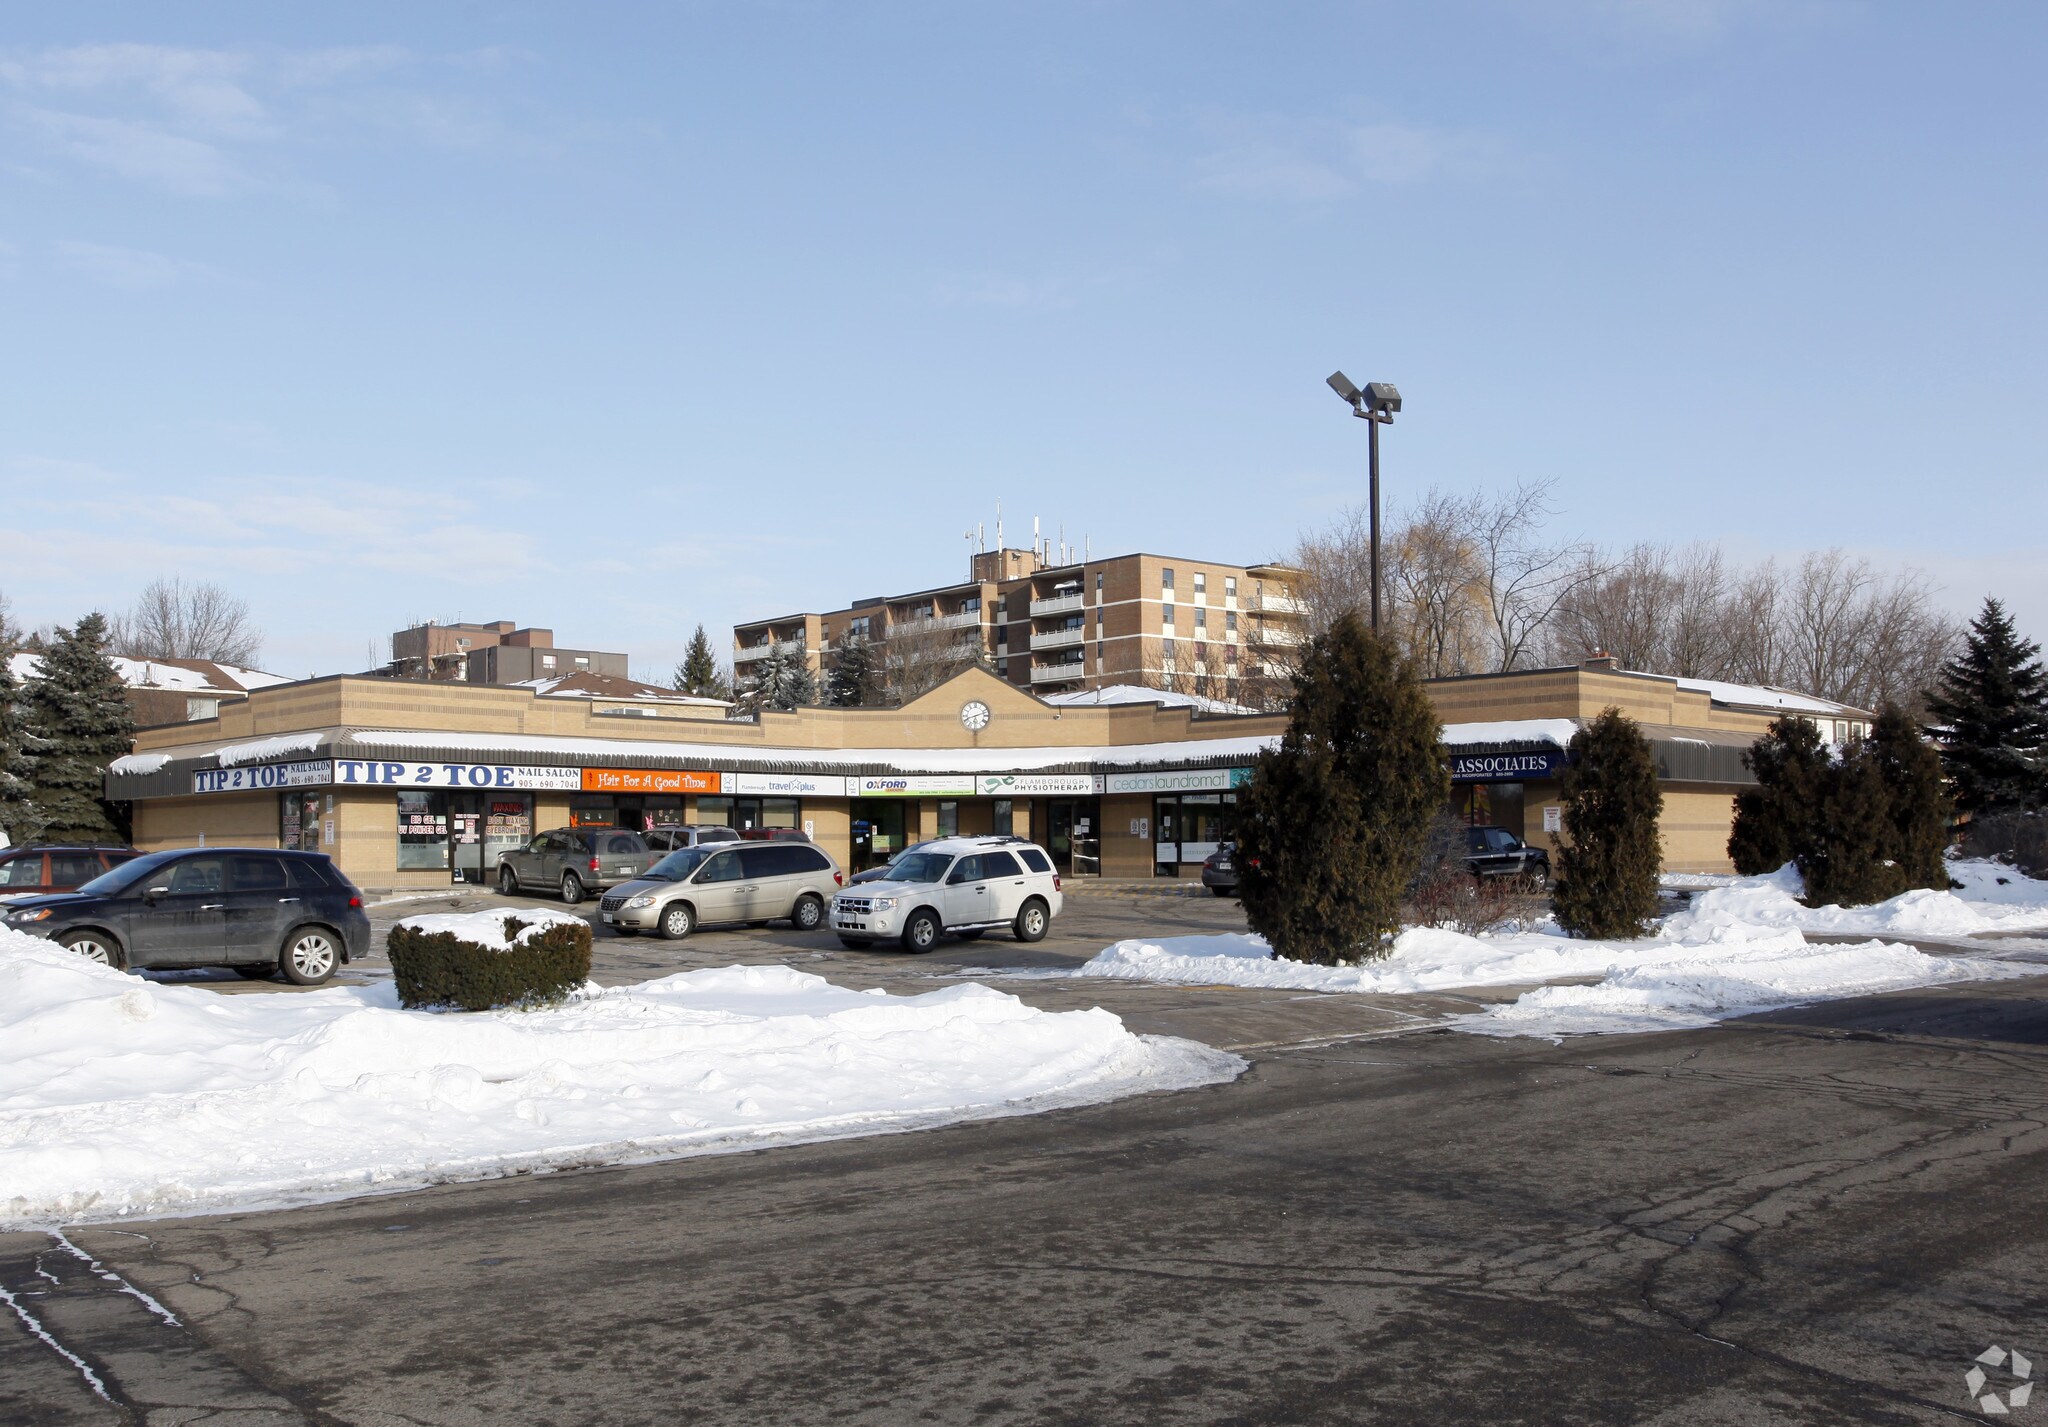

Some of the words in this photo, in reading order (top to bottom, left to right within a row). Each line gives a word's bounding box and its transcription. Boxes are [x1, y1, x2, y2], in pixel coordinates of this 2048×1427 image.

[290, 762, 307, 773] NAIL
[308, 761, 331, 771] SALON
[1456, 756, 1548, 773] ASSOCIATES
[196, 770, 229, 791] TIP
[232, 770, 243, 787] 2
[247, 764, 289, 788] TOE
[338, 761, 405, 784] TIP
[414, 765, 433, 783] 2
[443, 765, 515, 787] TOE
[518, 767, 544, 777] NAIL
[545, 768, 579, 778] SALON
[597, 773, 620, 788] Hair
[623, 775, 640, 787] For
[642, 775, 652, 787] A
[654, 775, 680, 791] Good
[682, 774, 706, 788] Time
[768, 781, 791, 791] travel
[799, 781, 816, 792] plus
[866, 779, 907, 789] OXFORD
[493, 803, 523, 813] WAXING
[411, 815, 422, 825] BIO
[423, 815, 435, 825] GEL
[505, 816, 529, 825] WAXING
[409, 825, 434, 834] POWDER
[435, 825, 448, 834] GEL
